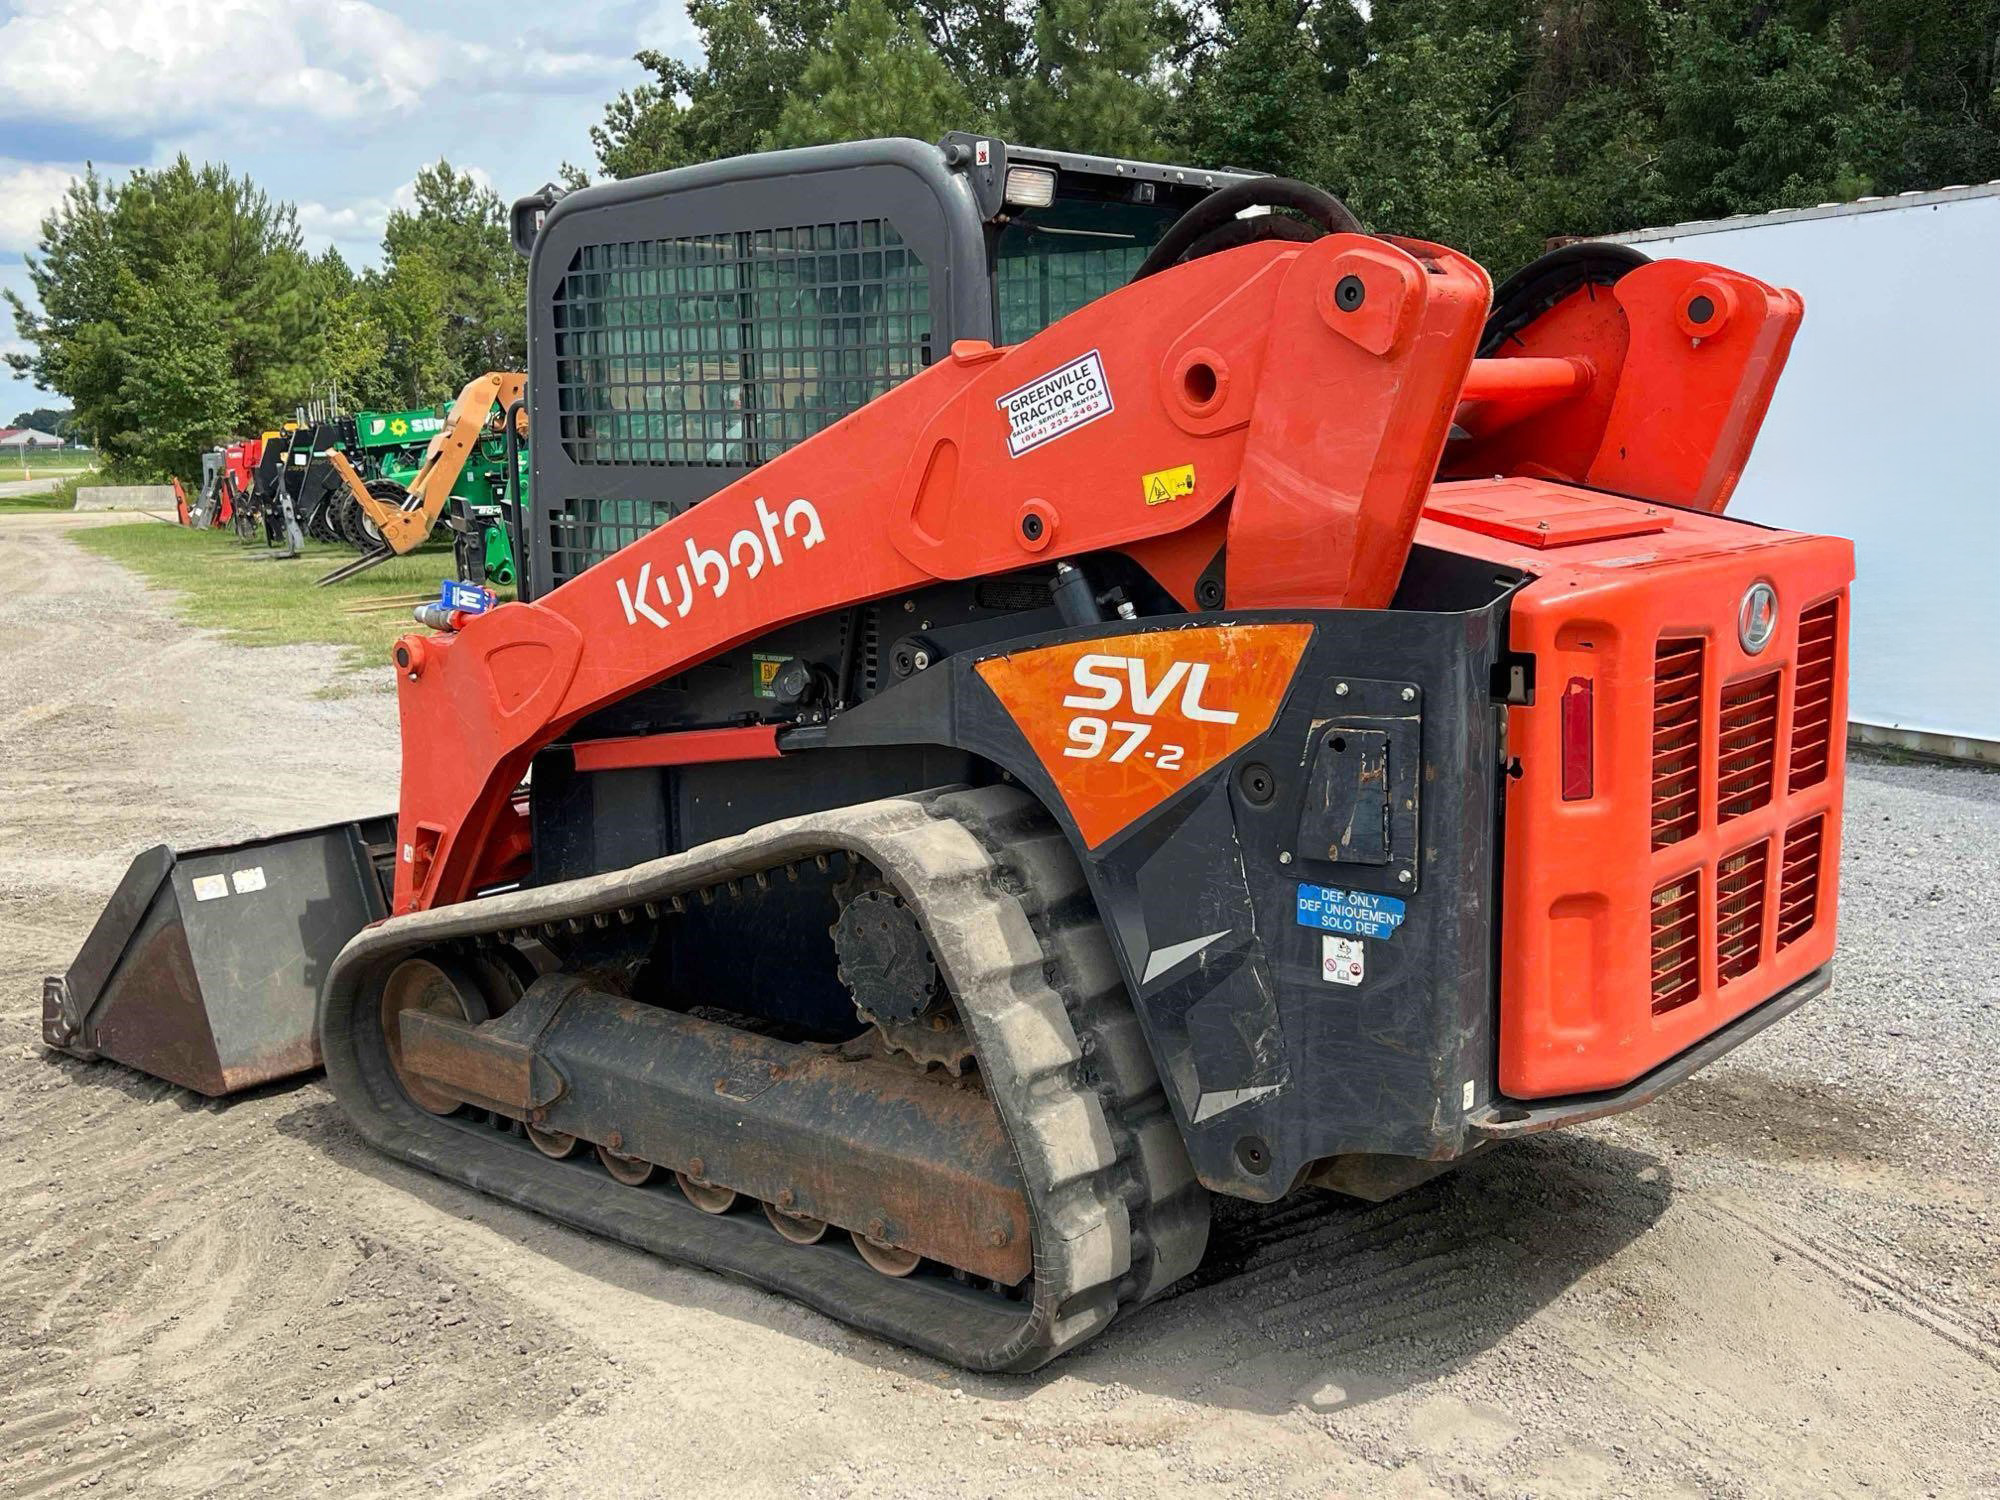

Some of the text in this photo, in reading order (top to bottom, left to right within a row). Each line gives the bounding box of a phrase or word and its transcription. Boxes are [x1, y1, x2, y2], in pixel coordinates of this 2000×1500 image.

[1010, 364, 1091, 412] GREENVILLE
[1012, 378, 1097, 427] TRACTOR CO
[1012, 424, 1033, 438] SALES
[1039, 408, 1067, 425] SERVICE
[1072, 390, 1103, 408] RENTALS
[1050, 401, 1099, 430] 232-2463
[616, 497, 826, 629] Kubota
[1063, 654, 1240, 724] SVL
[1063, 716, 1185, 771] 97-2
[1299, 898, 1321, 912] DEF
[1321, 890, 1379, 909] DEF ONLY
[1321, 915, 1379, 935] SOLO DEF
